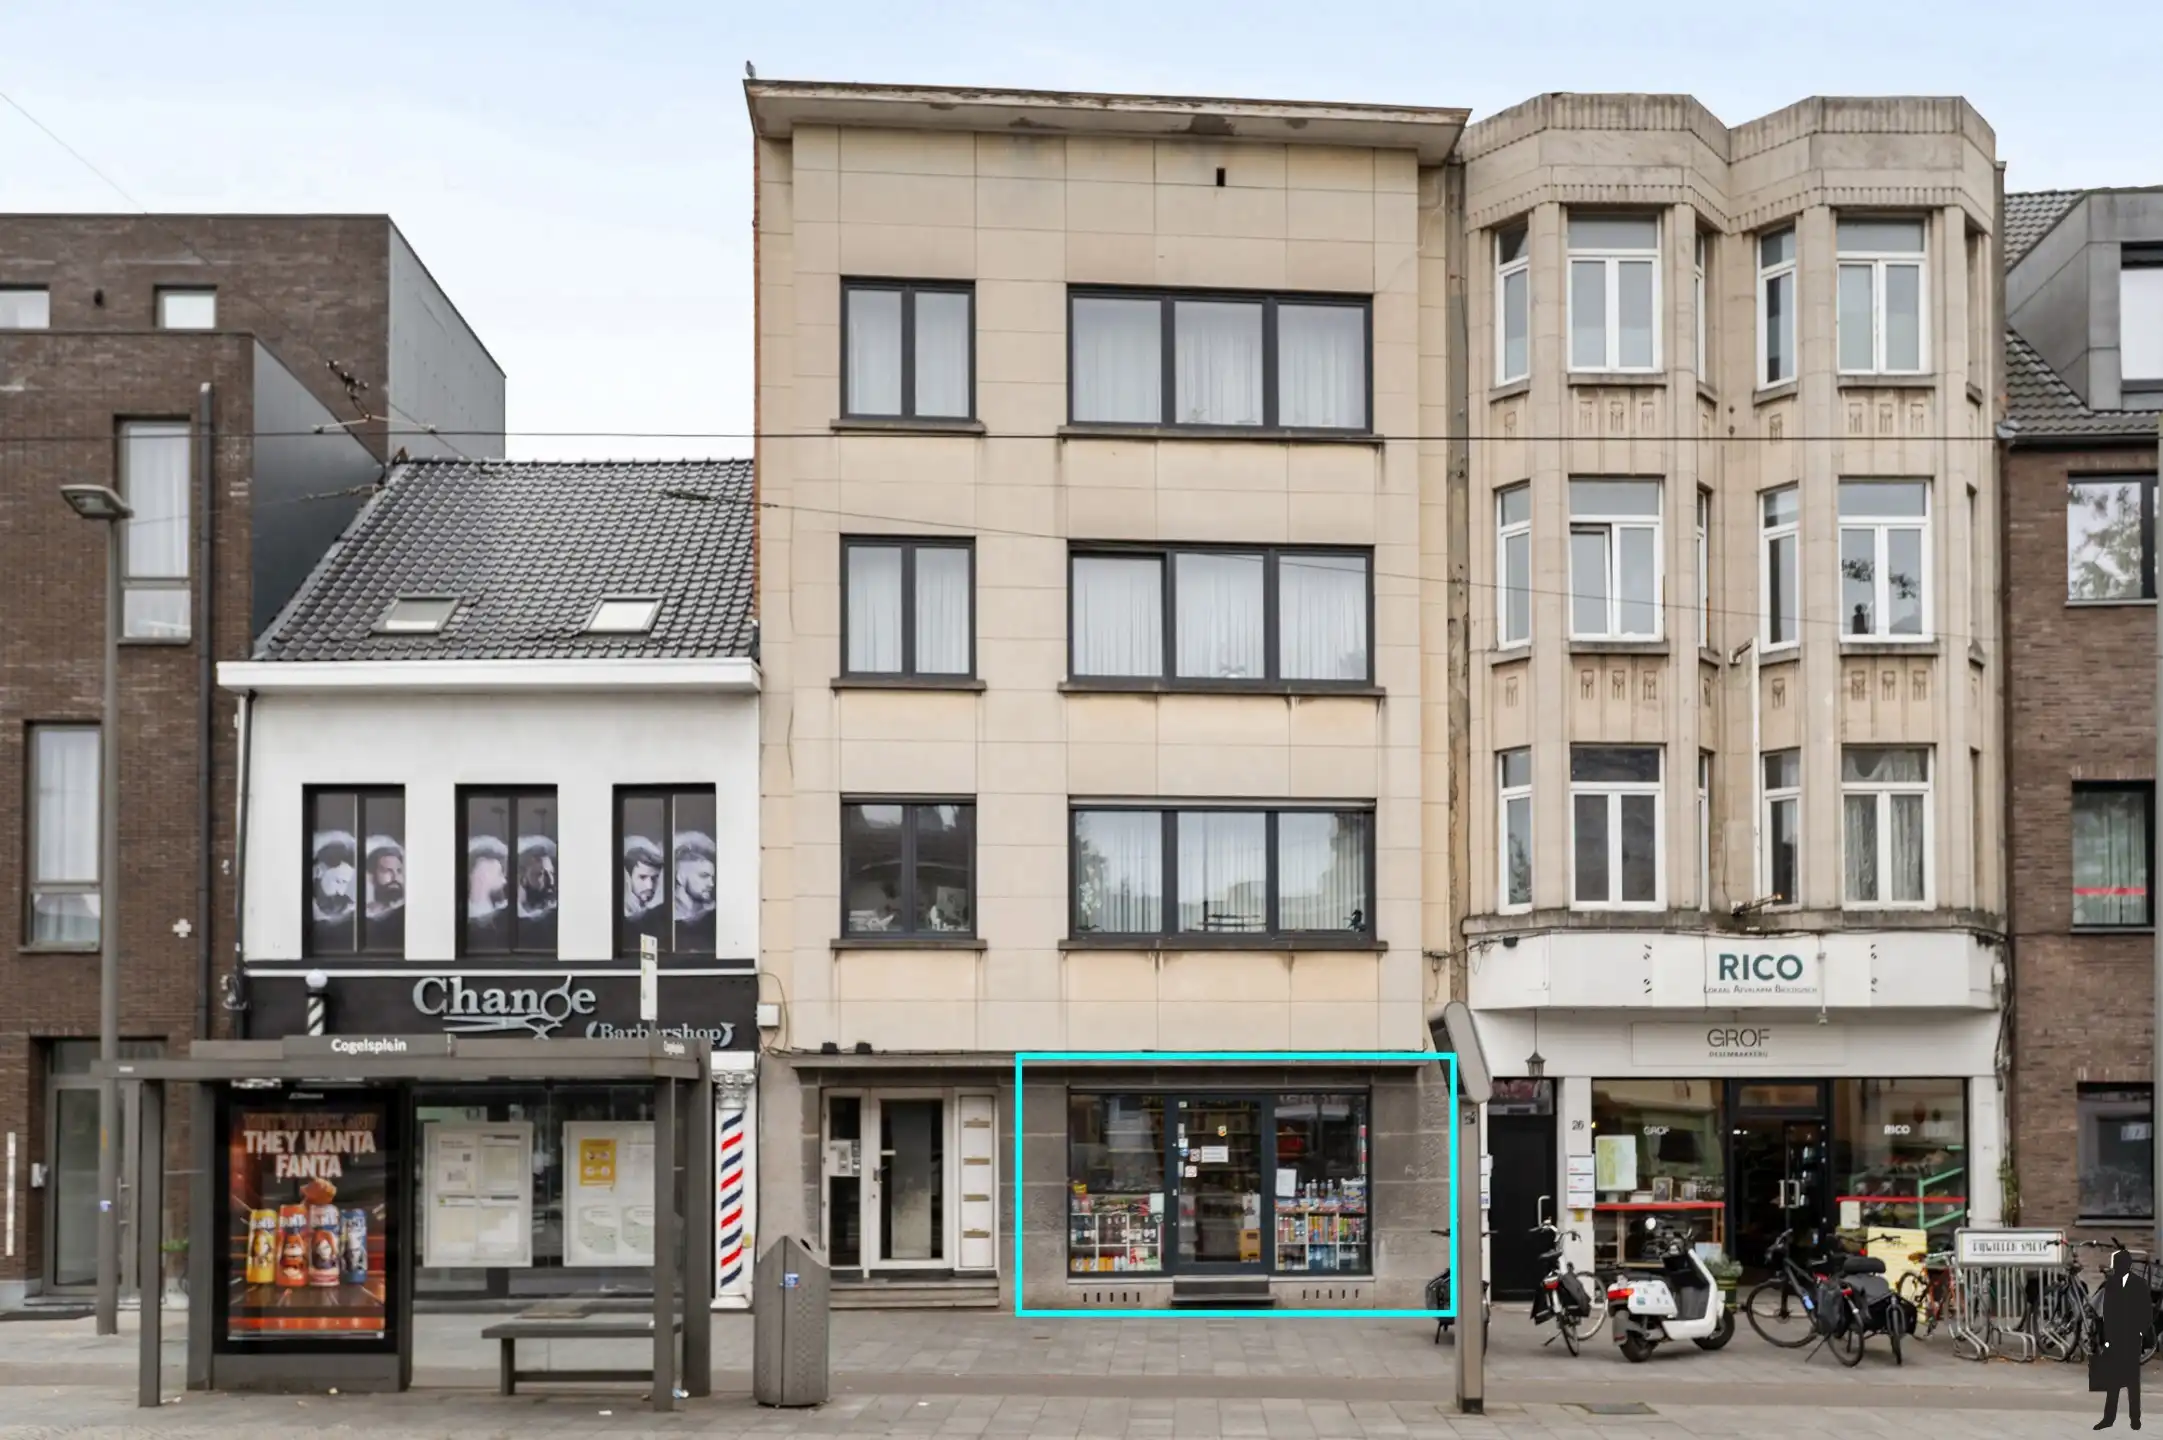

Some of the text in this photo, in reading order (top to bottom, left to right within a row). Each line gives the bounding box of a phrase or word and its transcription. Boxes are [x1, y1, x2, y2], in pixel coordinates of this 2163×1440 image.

[1719, 953, 1804, 981] RICO
[330, 1038, 408, 1055] Cogelsplein
[1706, 1028, 1771, 1048] GROF
[1571, 1120, 1585, 1131] 26
[1884, 1124, 1911, 1135] RICO
[243, 1130, 377, 1154] THEY WANTA
[275, 1154, 342, 1178] FANTA
